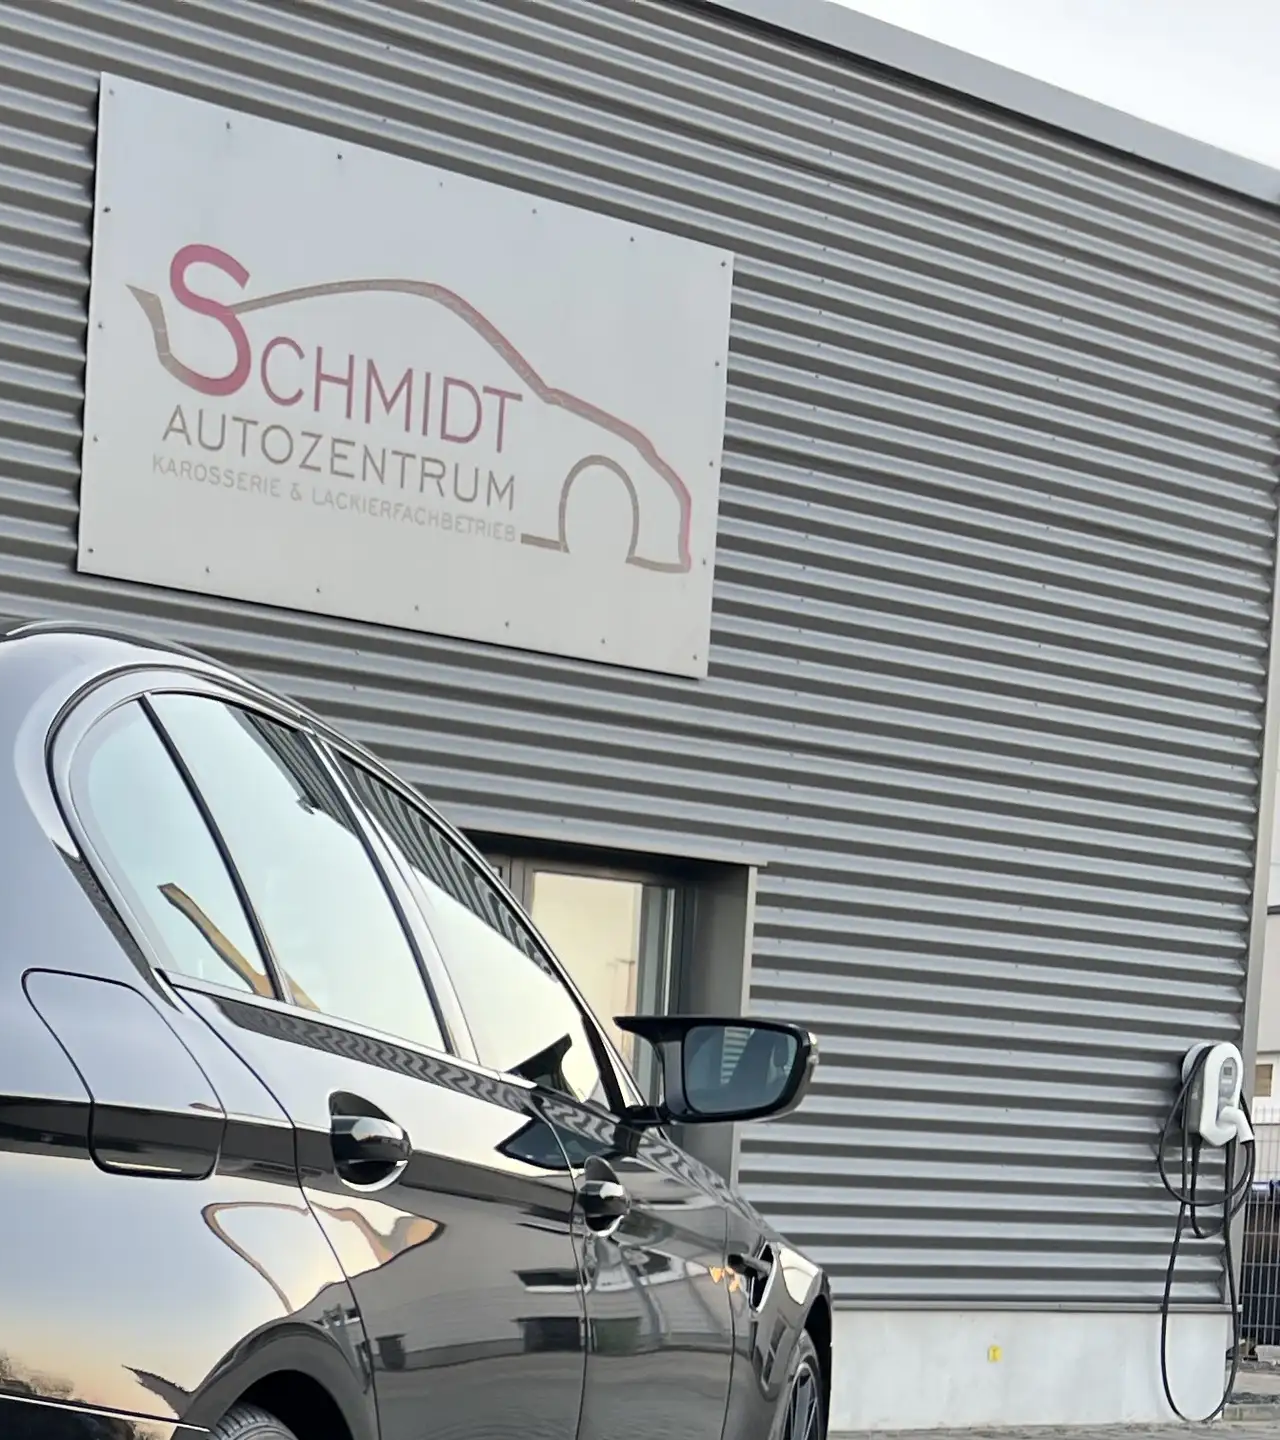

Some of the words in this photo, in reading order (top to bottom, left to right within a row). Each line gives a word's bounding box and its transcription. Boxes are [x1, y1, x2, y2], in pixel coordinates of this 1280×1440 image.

[169, 244, 523, 453] SCHMIDT
[152, 453, 282, 498] KAROSSERIE
[289, 481, 303, 502] &
[311, 486, 516, 543] LACKIERFACHBETRIEB
[161, 404, 516, 512] AUTOZENTRUM
